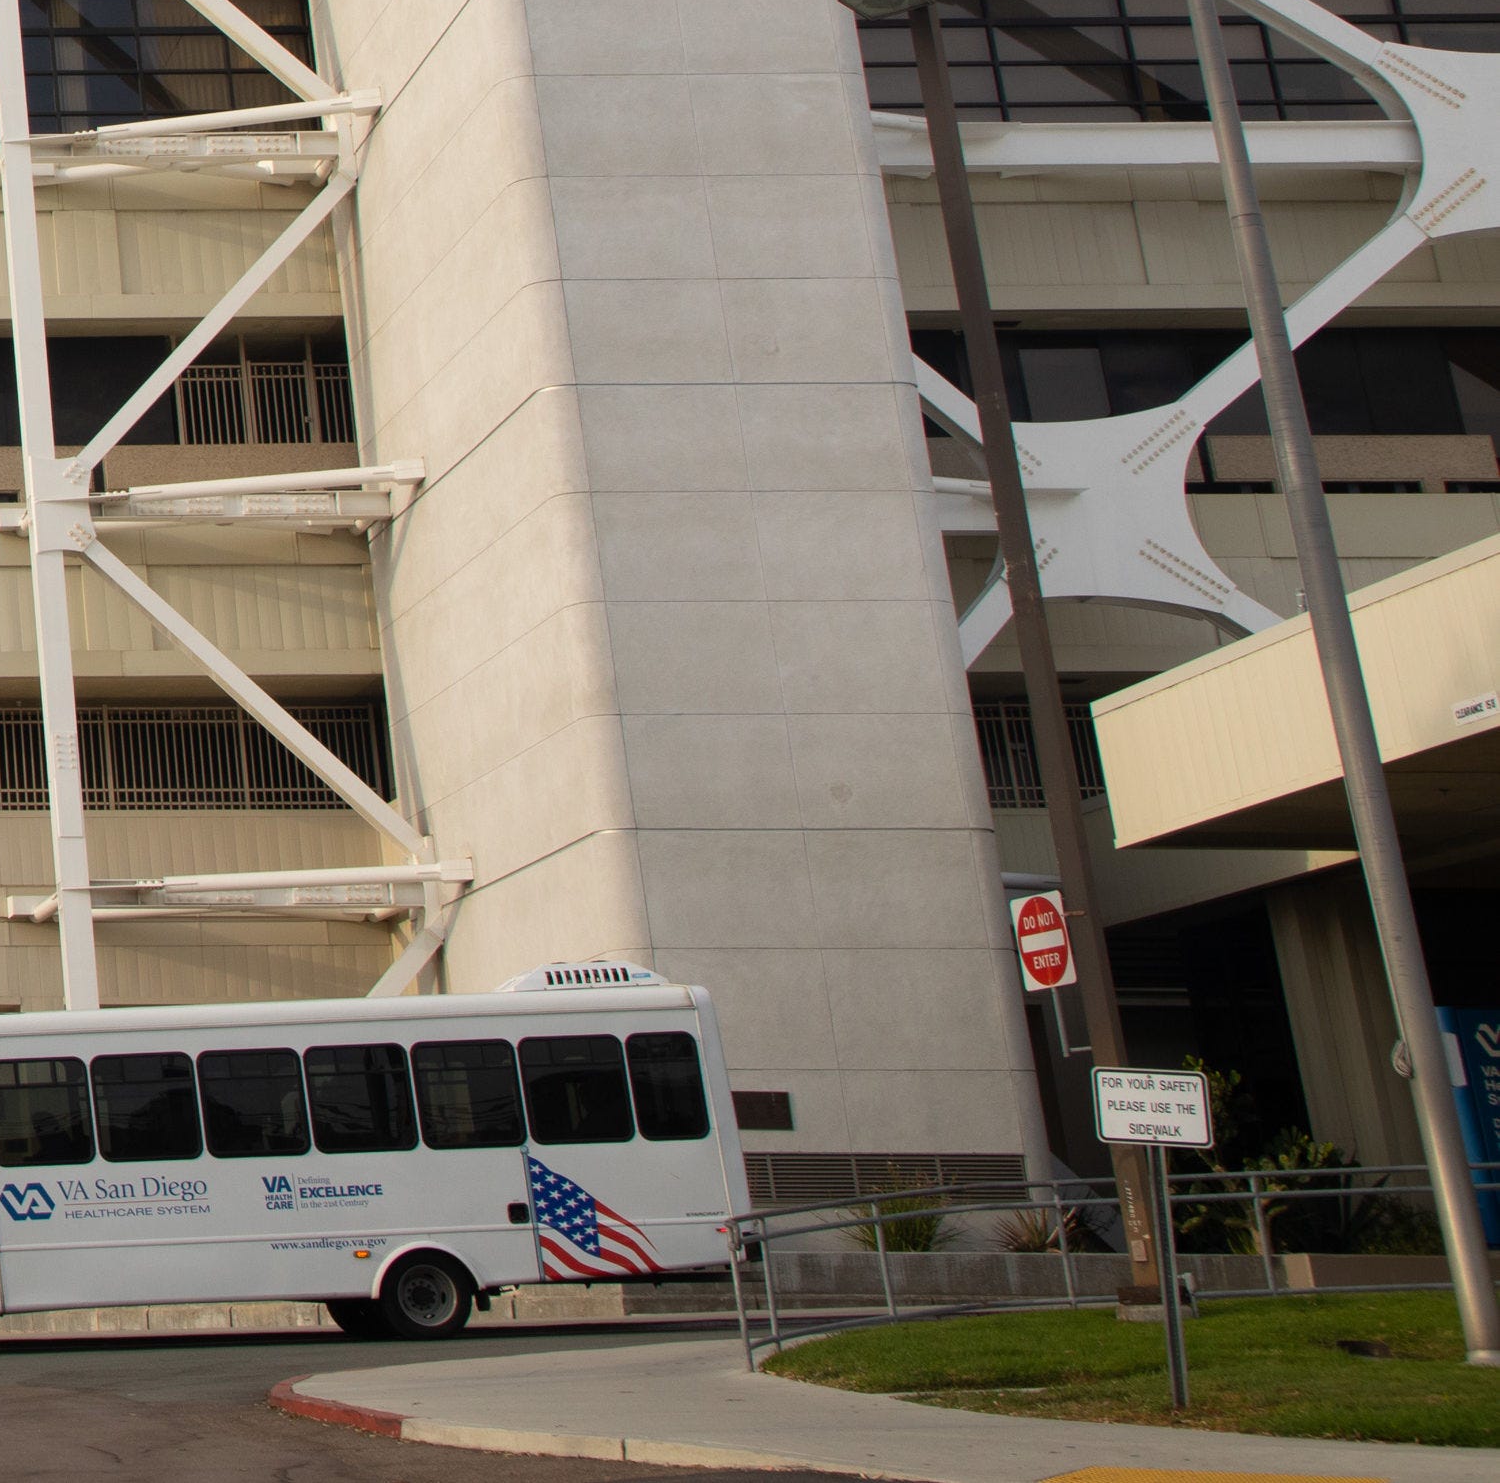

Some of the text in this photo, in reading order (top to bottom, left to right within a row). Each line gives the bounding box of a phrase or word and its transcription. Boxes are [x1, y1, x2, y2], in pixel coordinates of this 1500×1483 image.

[1023, 911, 1054, 930] DO NOT
[1033, 952, 1061, 970] ENTER
[1101, 1076, 1198, 1092] FOR YOUR SAFETY
[1107, 1100, 1196, 1115] PLEASE USE THE
[1129, 1122, 1182, 1136] SIDEWALK
[262, 1176, 292, 1193] VA
[298, 1176, 331, 1185] Defining
[57, 1180, 89, 1201] VA
[95, 1178, 135, 1199] San
[142, 1176, 207, 1202] Diego
[299, 1184, 383, 1198] EXCELLENCE
[266, 1201, 294, 1210] CARE
[310, 1200, 322, 1208] the
[324, 1200, 338, 1208] 21st
[339, 1199, 369, 1208] Century
[65, 1204, 211, 1219] HEALTHCARE SYSTEM
[270, 1237, 387, 1251] www.sandiego.va.gov
